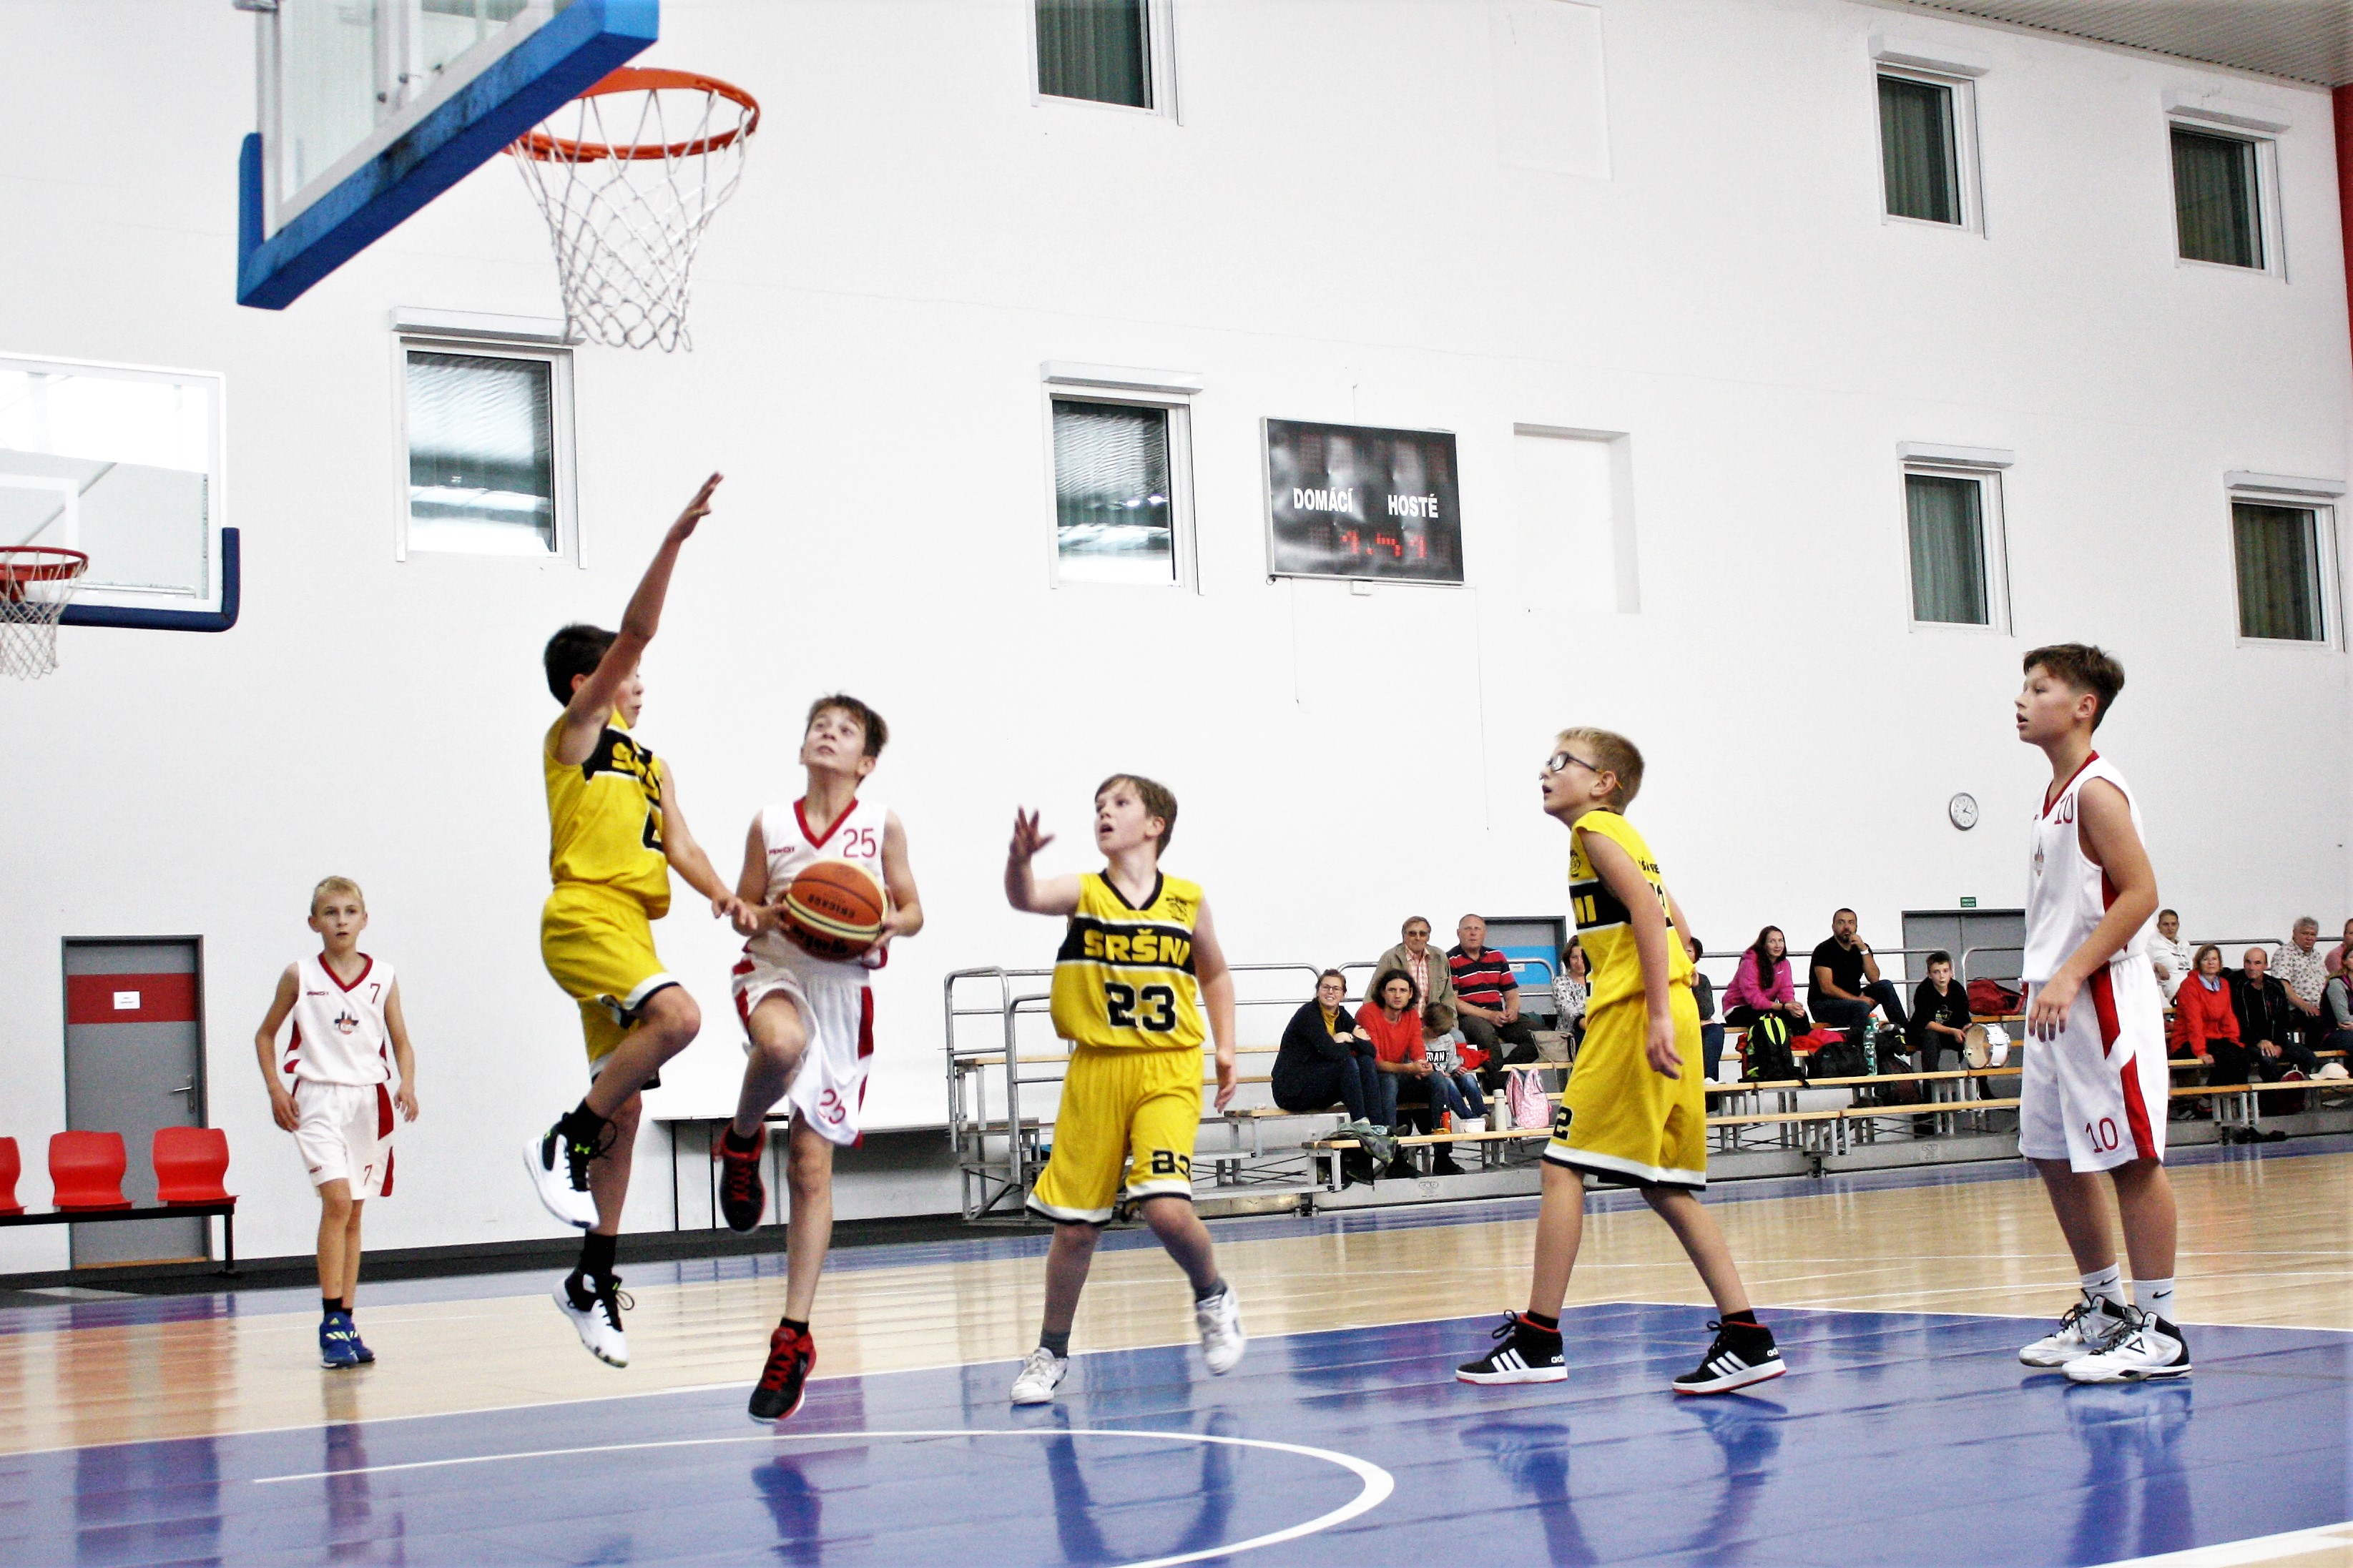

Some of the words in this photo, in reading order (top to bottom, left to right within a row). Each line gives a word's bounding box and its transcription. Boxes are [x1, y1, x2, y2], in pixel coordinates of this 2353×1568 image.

[1293, 487, 1354, 513] DOMÁCÍ
[1387, 493, 1439, 518] HOSTÉ
[2054, 791, 2073, 825] 10
[843, 827, 877, 859] 25
[370, 982, 381, 1005] 7
[1104, 982, 1176, 1032] 23
[817, 1088, 846, 1125] 25
[2086, 1117, 2118, 1153] 10
[363, 1163, 373, 1186] 7
